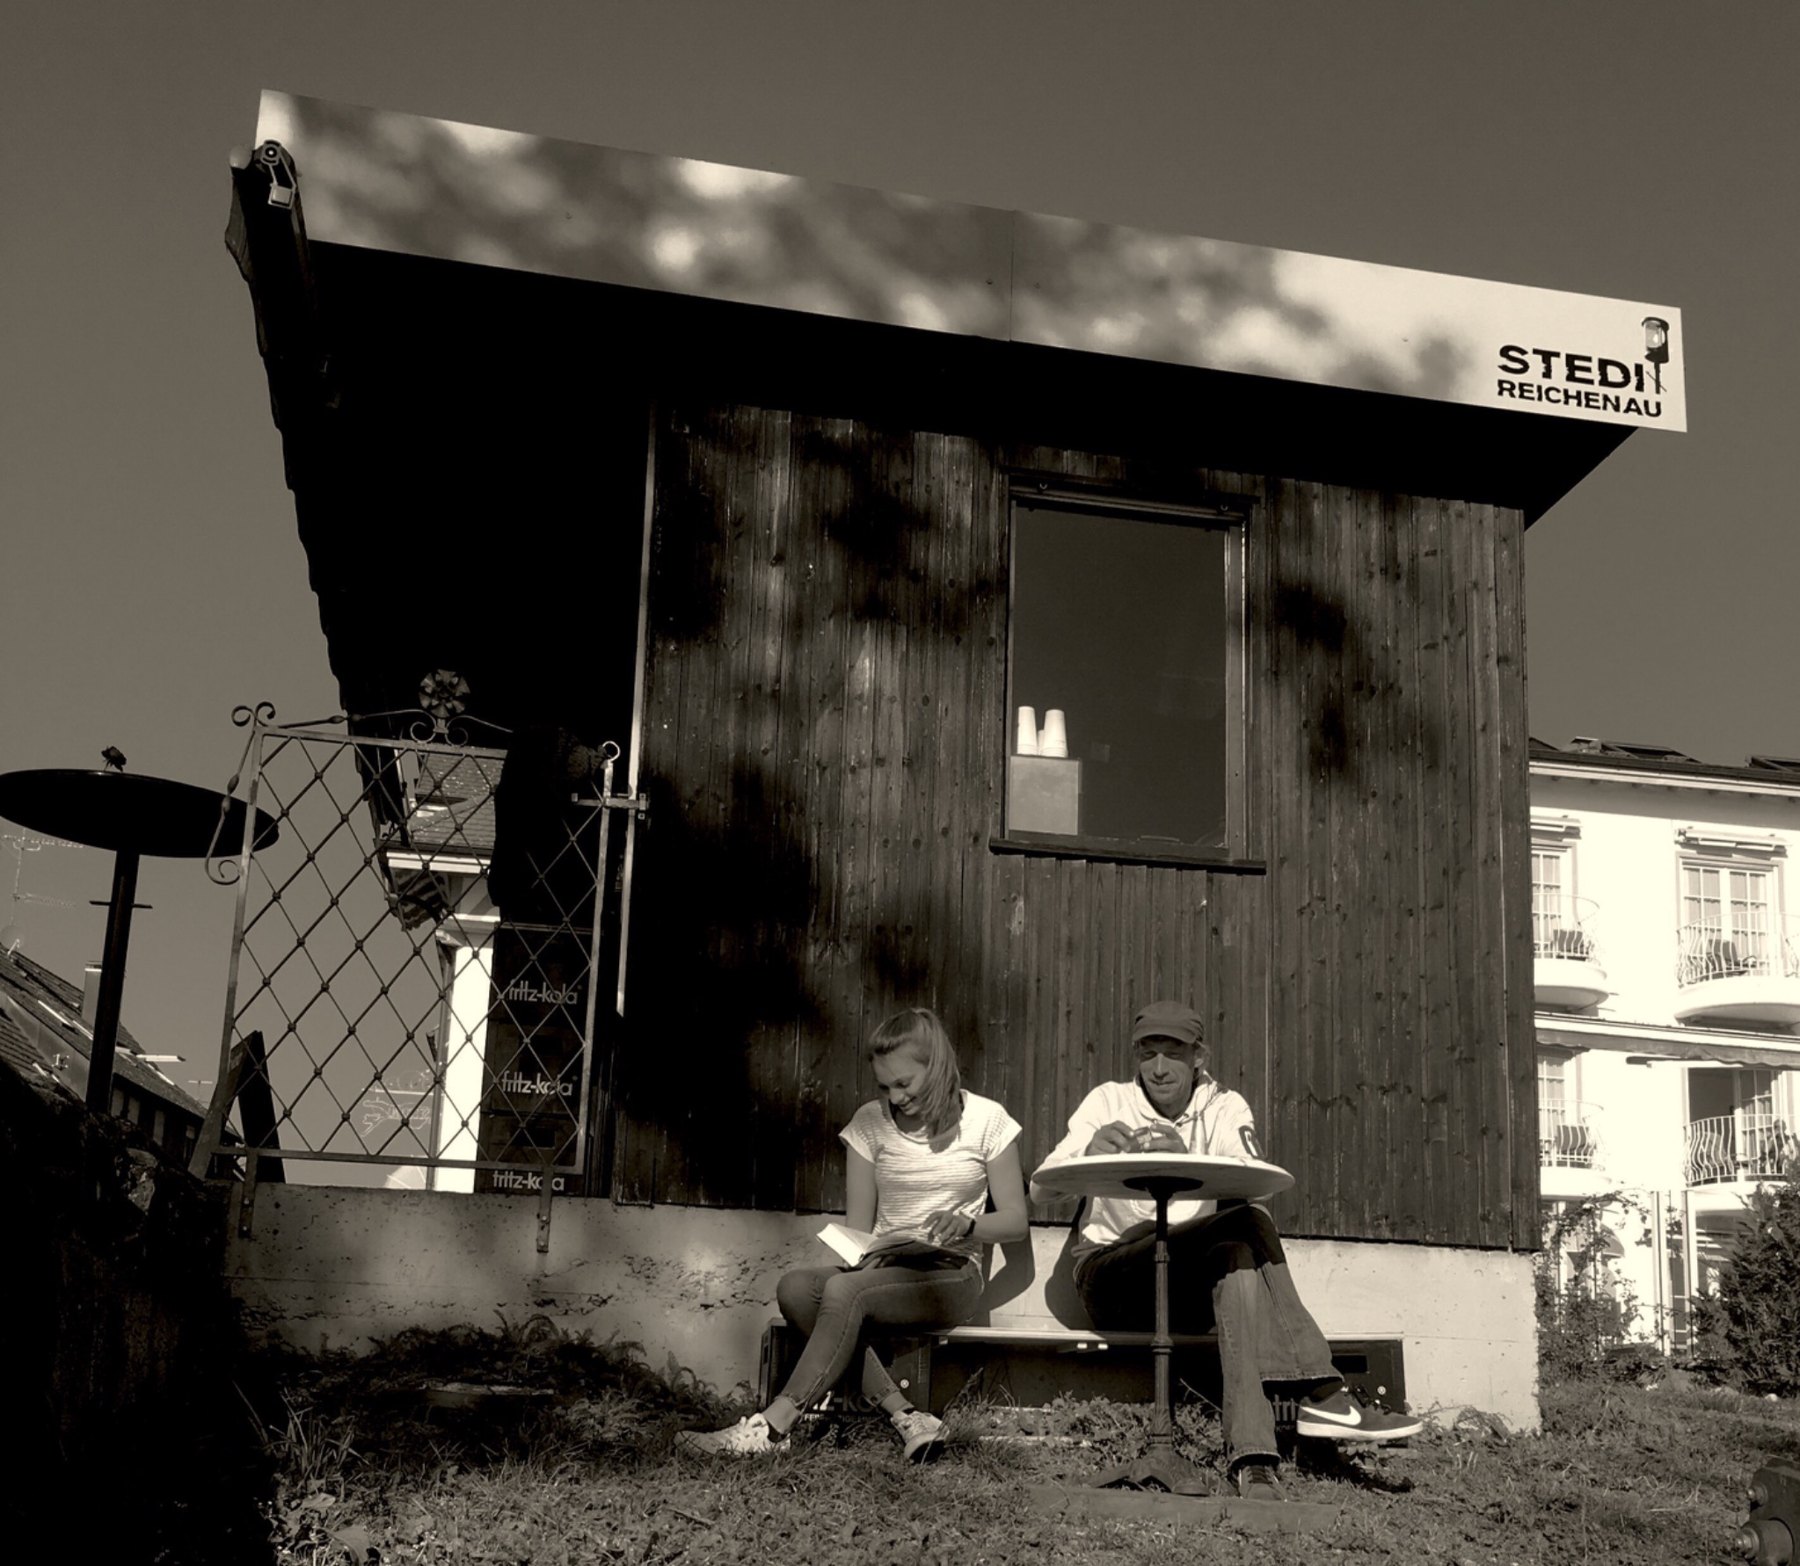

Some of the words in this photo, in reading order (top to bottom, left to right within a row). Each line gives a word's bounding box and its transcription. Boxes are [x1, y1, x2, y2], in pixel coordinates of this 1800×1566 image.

[1498, 344, 1645, 393] STEDI
[1497, 379, 1662, 418] REICHENAU
[493, 1170, 566, 1191] fritz-koa
